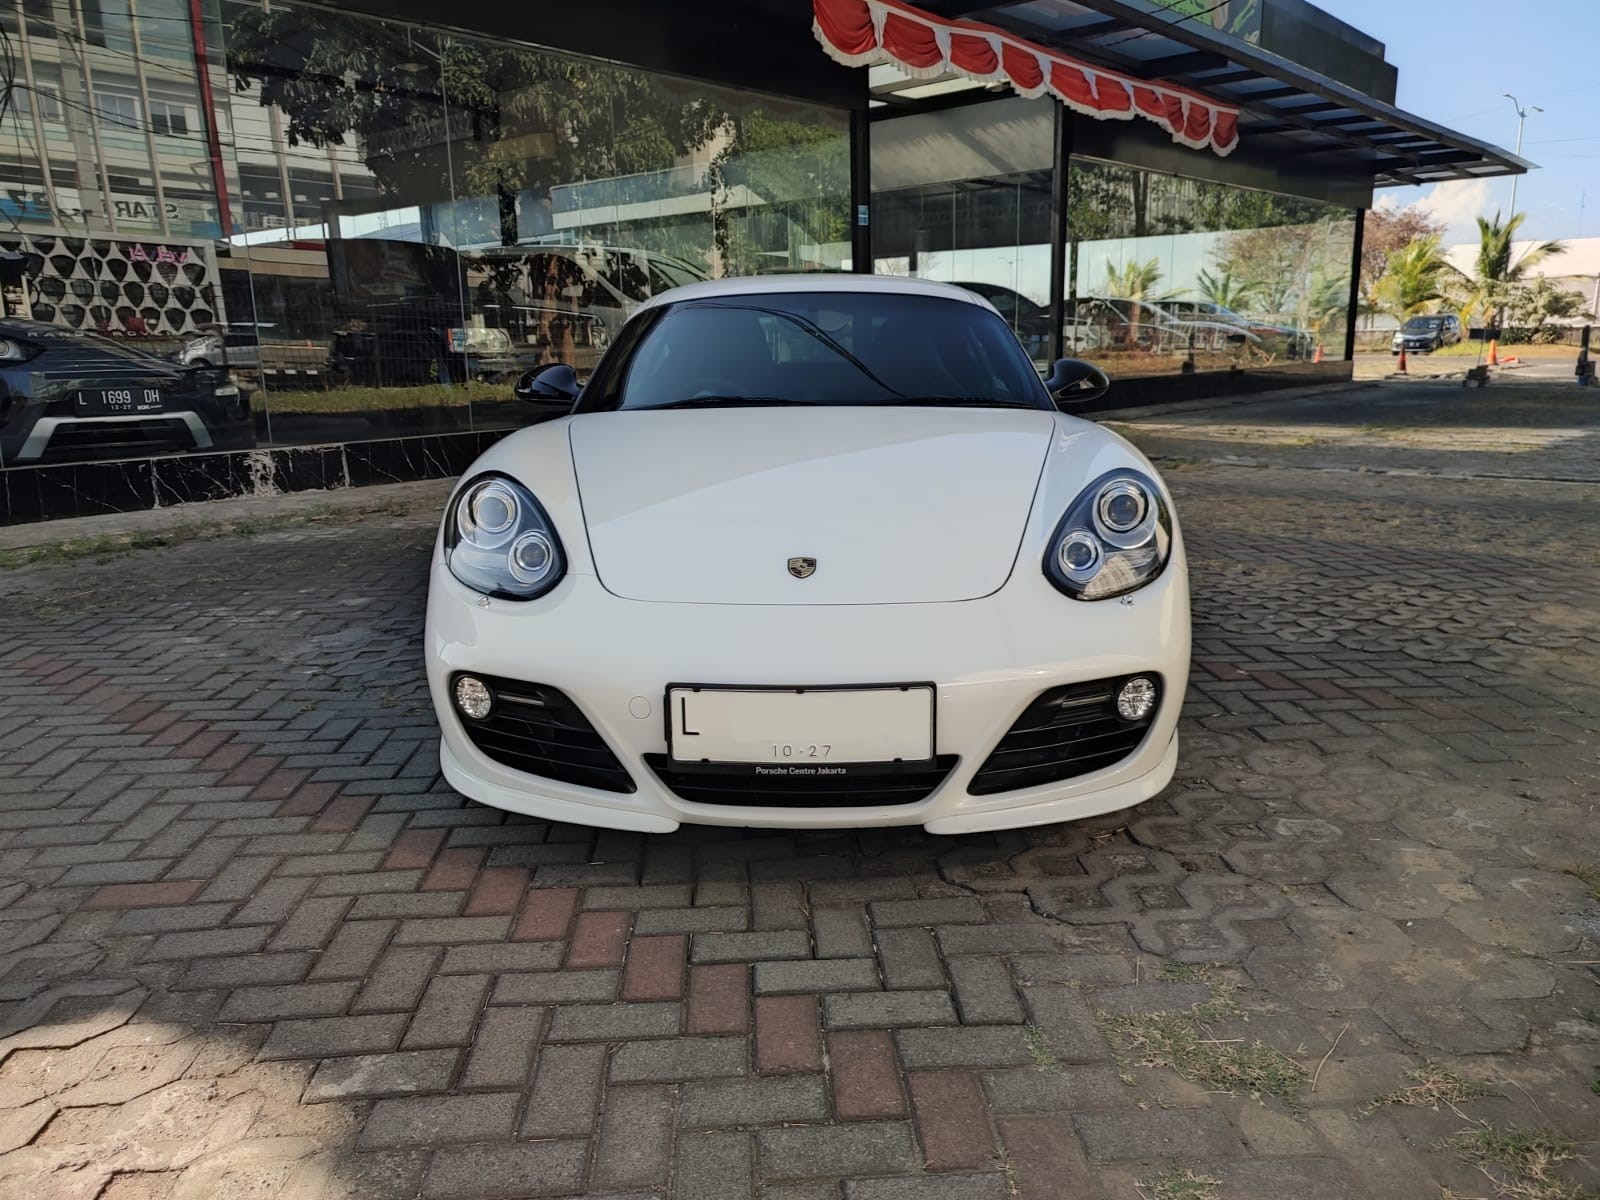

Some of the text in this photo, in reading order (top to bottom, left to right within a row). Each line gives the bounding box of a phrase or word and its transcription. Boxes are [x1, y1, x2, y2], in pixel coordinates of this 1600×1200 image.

[78, 389, 160, 405] L 1699 DH
[681, 697, 700, 736] L
[755, 766, 847, 775] Porsche Centre Jakarta
